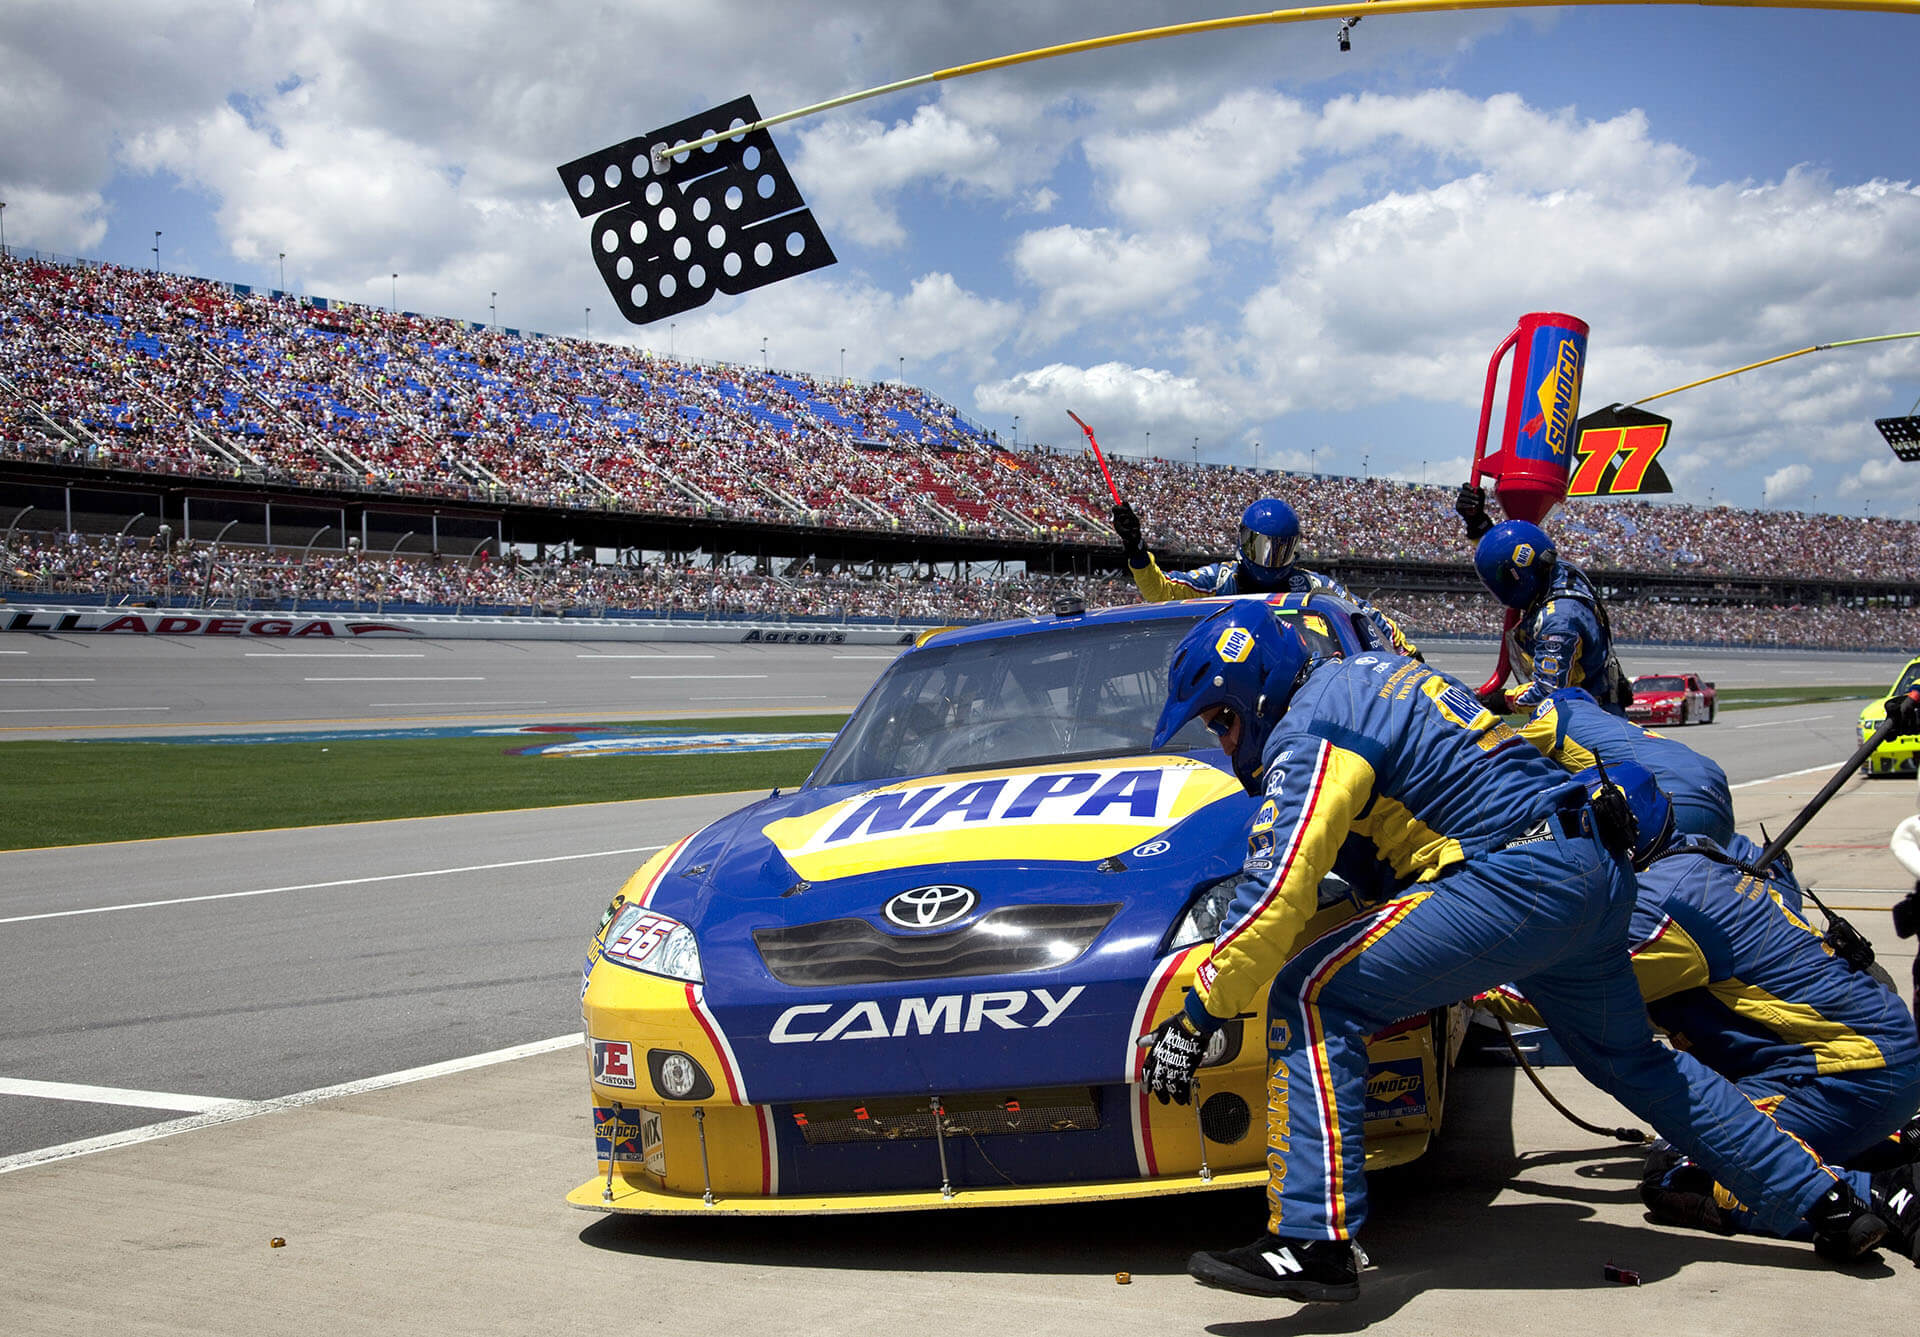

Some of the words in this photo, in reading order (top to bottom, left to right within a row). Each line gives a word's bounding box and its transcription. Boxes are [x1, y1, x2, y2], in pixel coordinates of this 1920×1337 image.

[1548, 348, 1579, 451] SUNOCO
[1567, 423, 1668, 496] 77
[0, 613, 335, 637] LLADEGA
[743, 629, 846, 643] Aaron's
[1222, 631, 1249, 660] NAPA
[824, 769, 1162, 844] NAPA
[607, 915, 680, 962] 56
[769, 986, 1085, 1044] CAMRY
[594, 1042, 629, 1077] JE
[602, 1075, 635, 1087] PISTONS
[1366, 1076, 1420, 1096] UNOCO
[1266, 1058, 1291, 1153] PARTS
[642, 1116, 662, 1149] WIX
